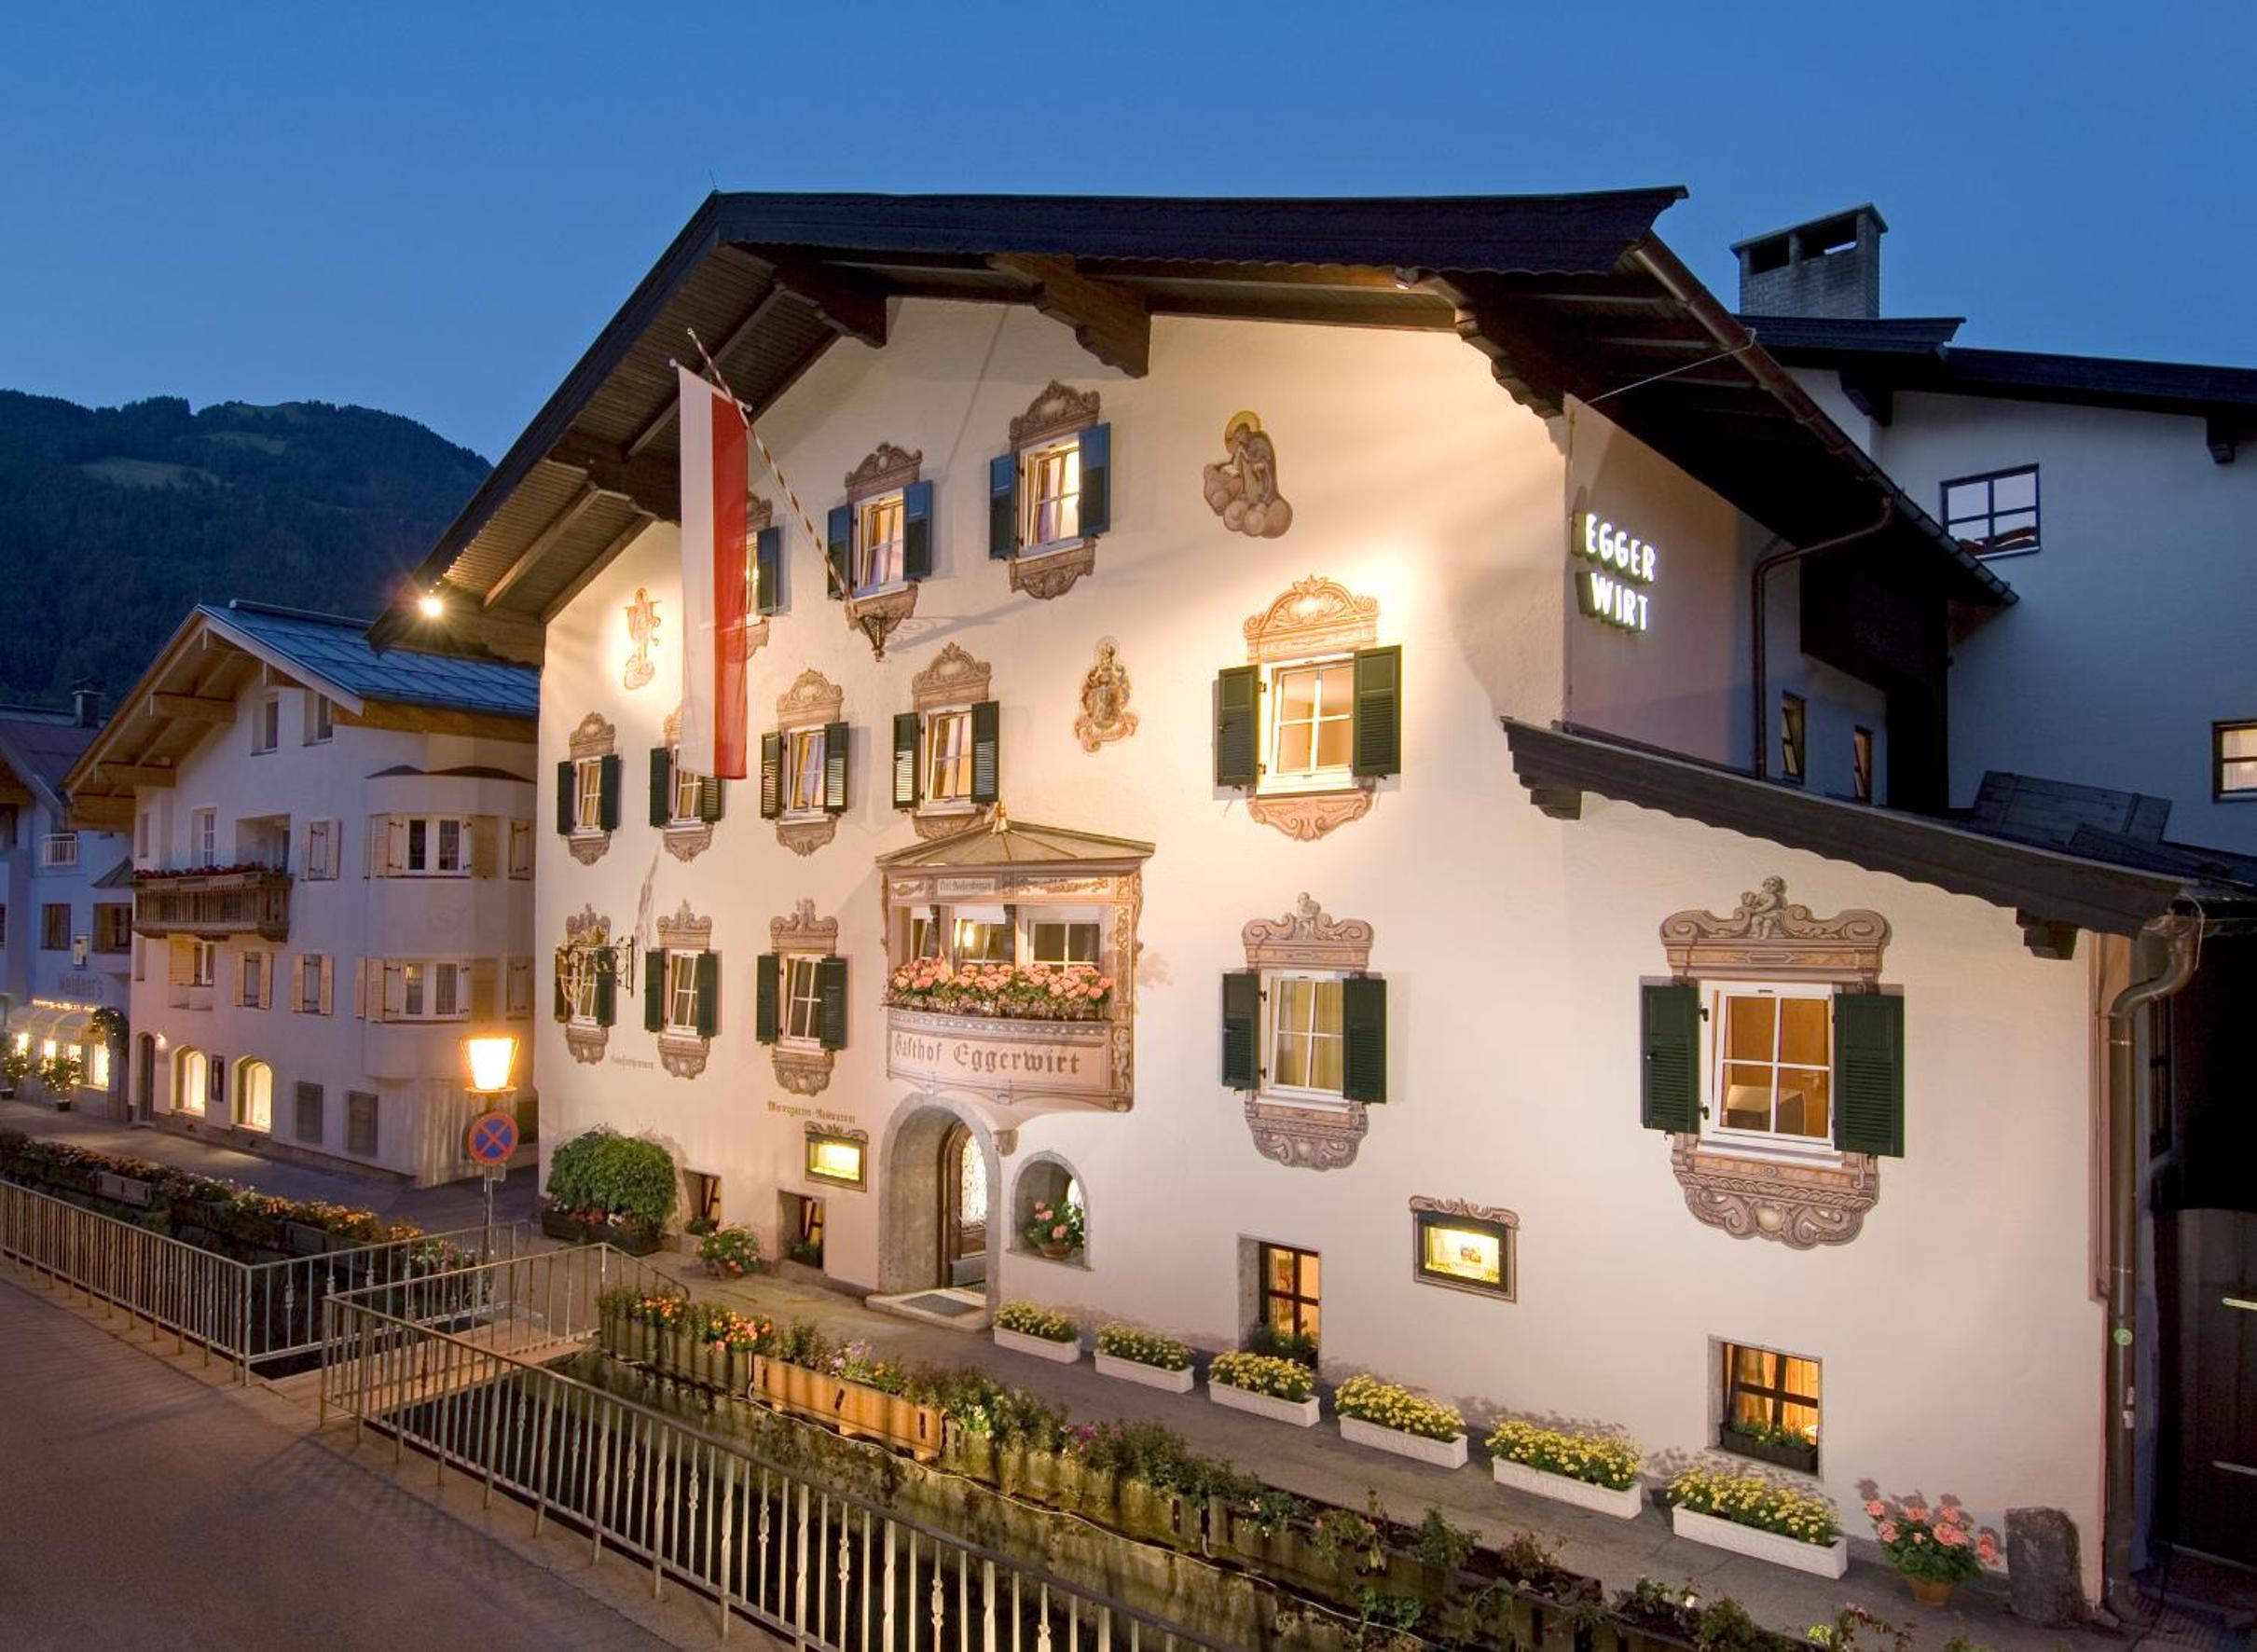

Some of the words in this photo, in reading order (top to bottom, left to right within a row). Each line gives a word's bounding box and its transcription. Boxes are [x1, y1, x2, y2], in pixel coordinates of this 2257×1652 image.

[1586, 514, 1656, 582] EGGER
[1590, 572, 1648, 630] WIRT
[954, 1041, 1080, 1074] Eggerwirt
